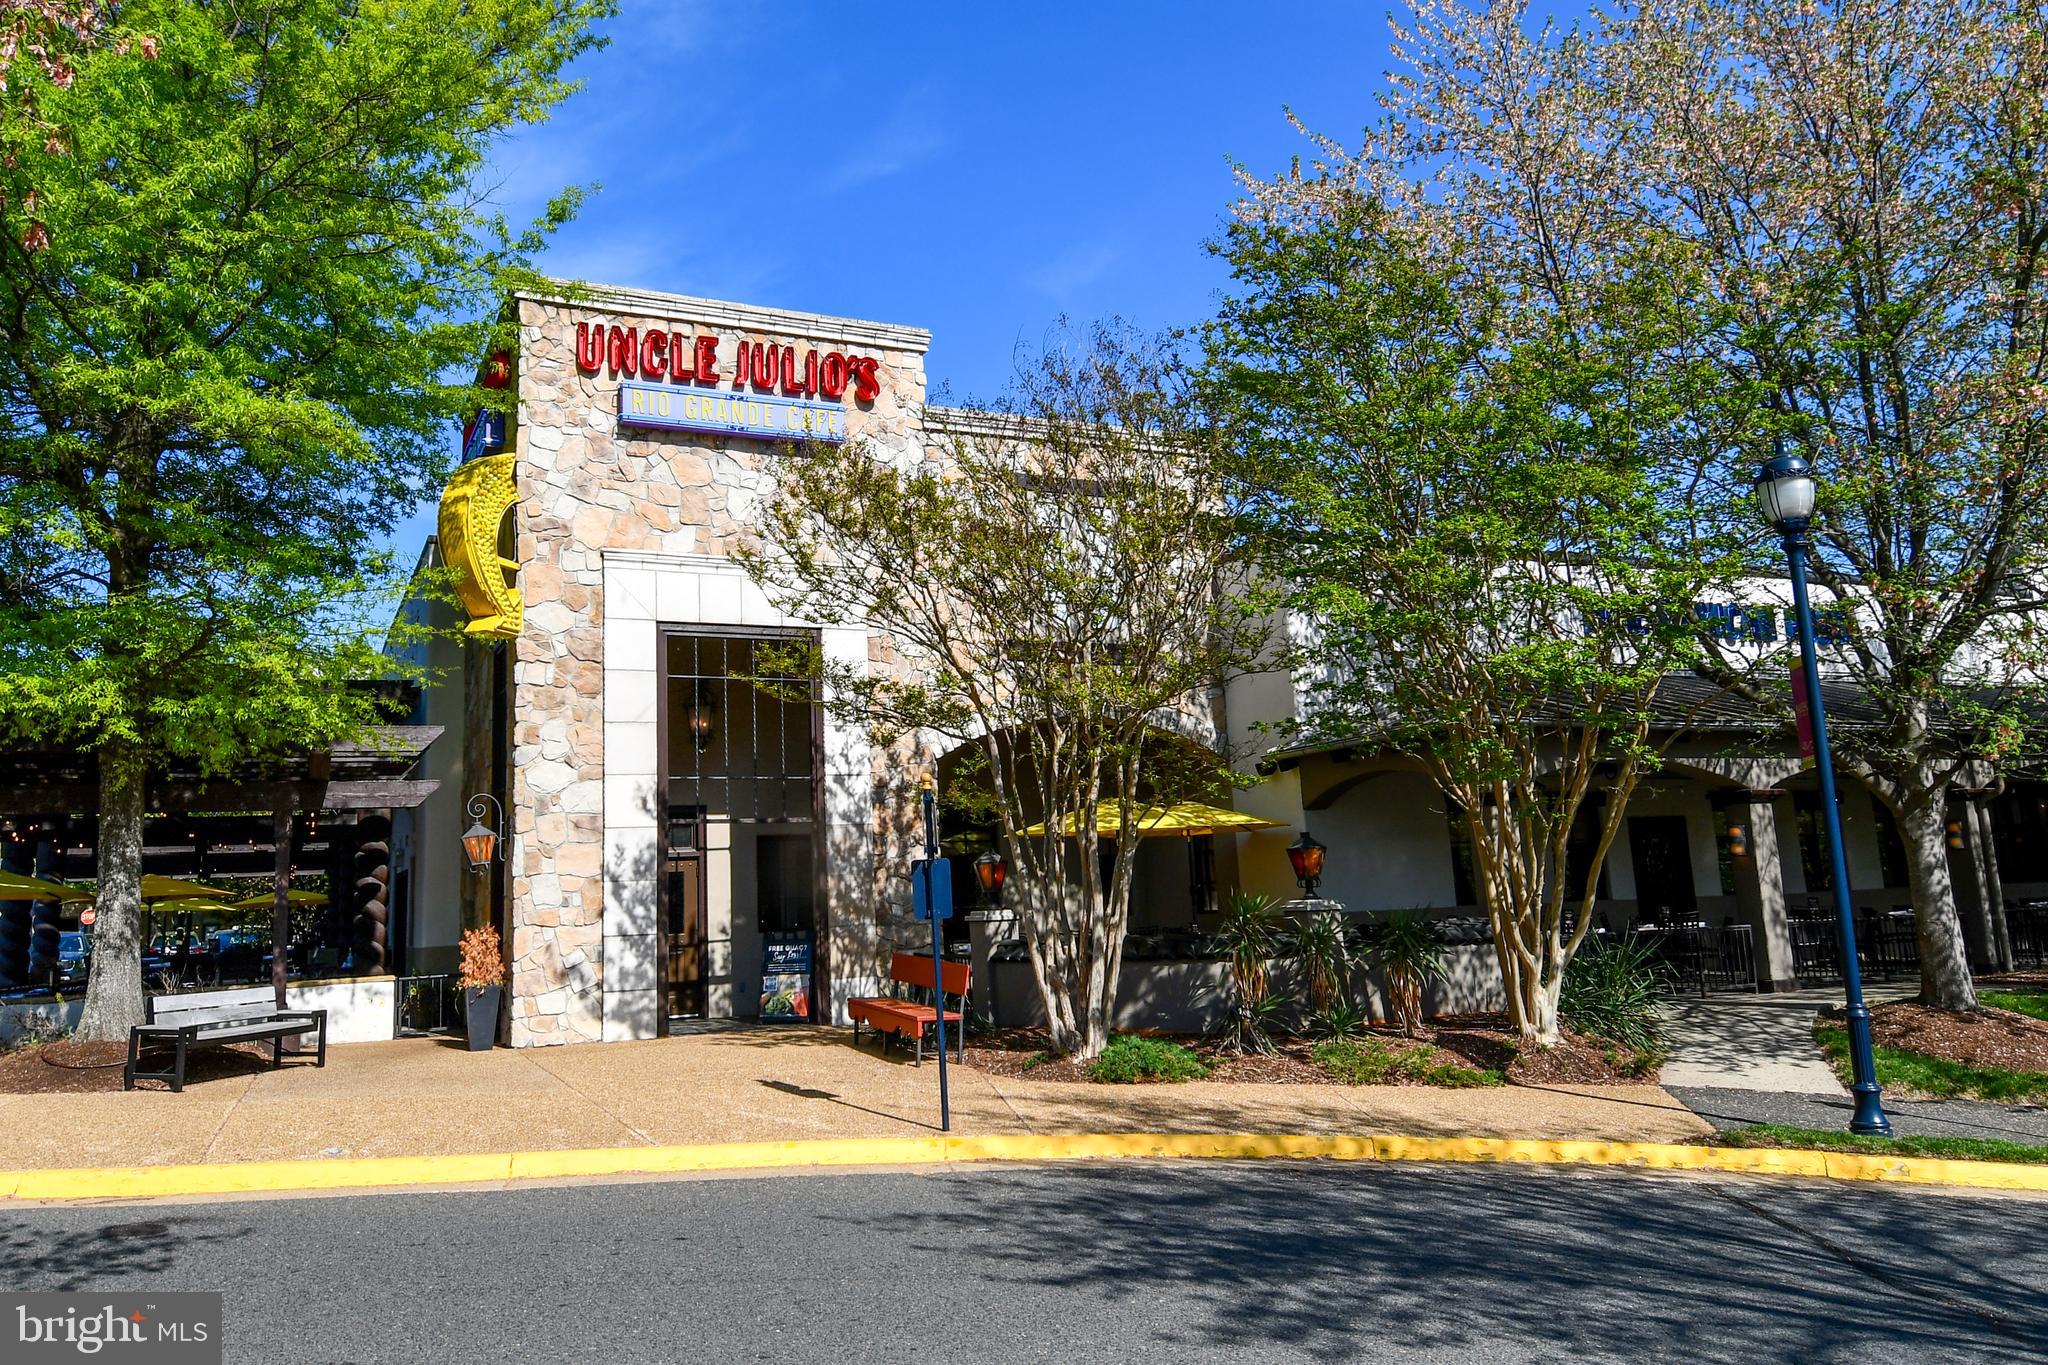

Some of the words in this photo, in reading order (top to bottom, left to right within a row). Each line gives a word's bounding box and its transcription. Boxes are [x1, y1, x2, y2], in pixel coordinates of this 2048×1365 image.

[576, 321, 720, 384] UNCLE
[733, 341, 880, 402] JULIO'S
[632, 389, 670, 417] RIO
[685, 395, 774, 429] GRANDE
[786, 406, 838, 434] CAFE
